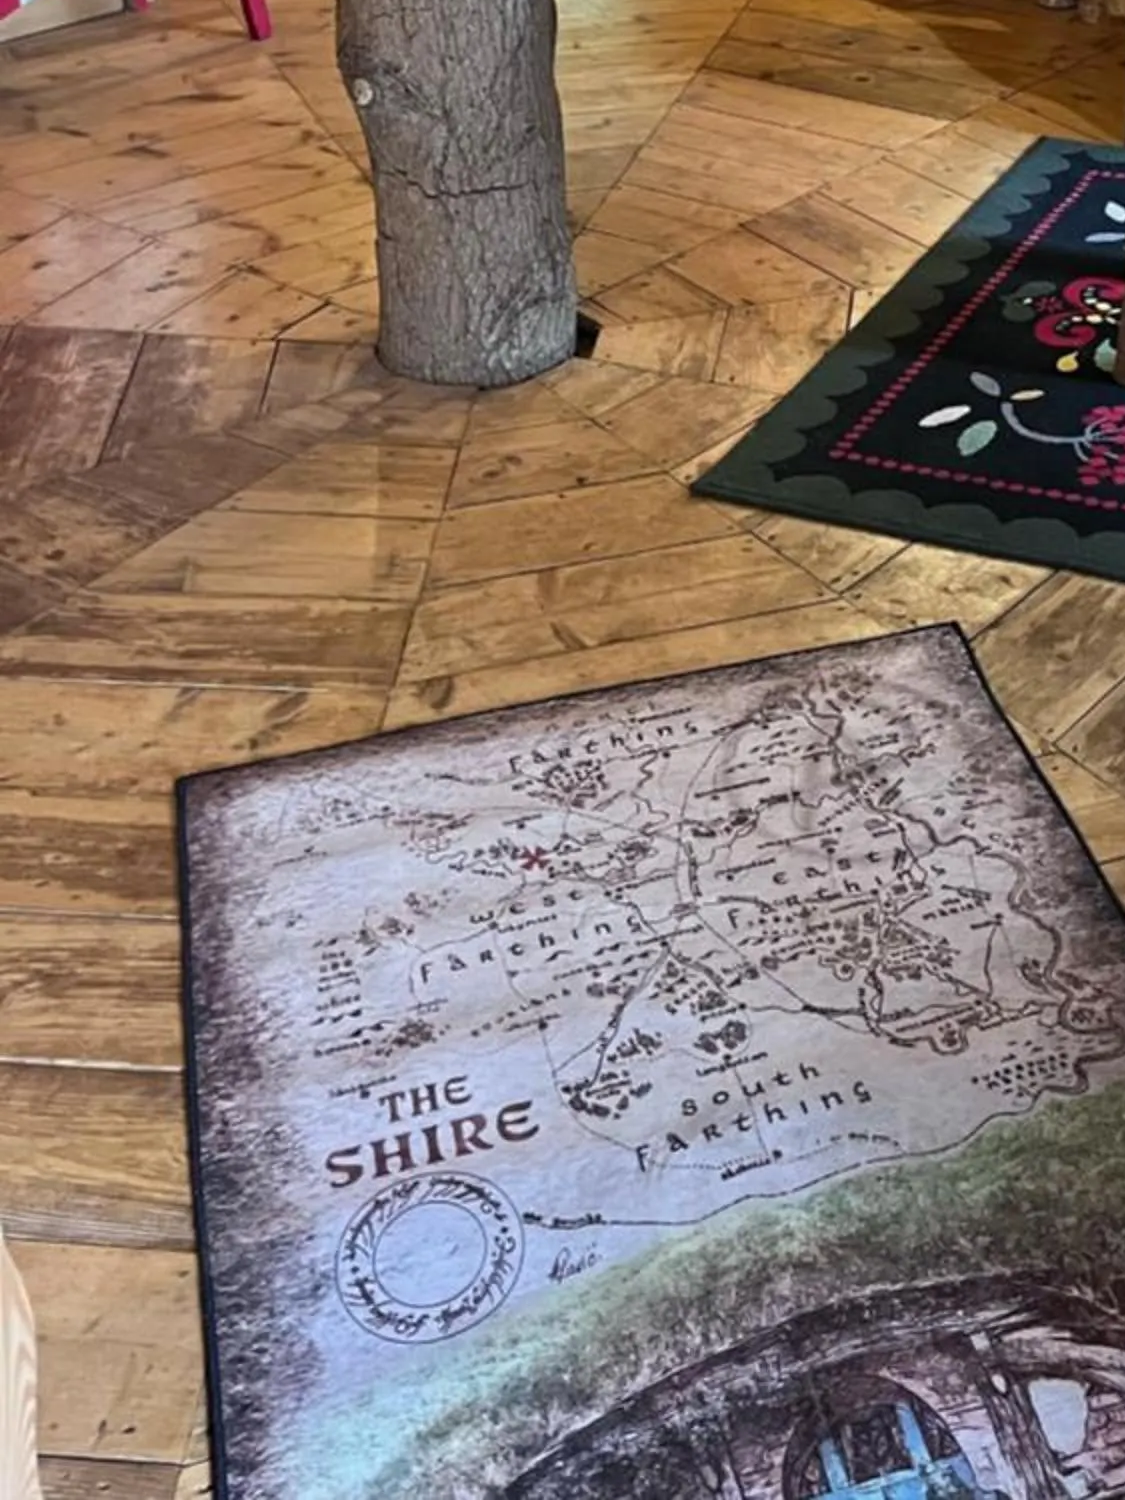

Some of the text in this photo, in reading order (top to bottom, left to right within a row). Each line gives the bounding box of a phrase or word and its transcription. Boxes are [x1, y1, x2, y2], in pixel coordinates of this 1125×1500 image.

[379, 1074, 473, 1123] THE
[681, 1062, 820, 1117] south
[324, 1100, 540, 1188] SHIRE
